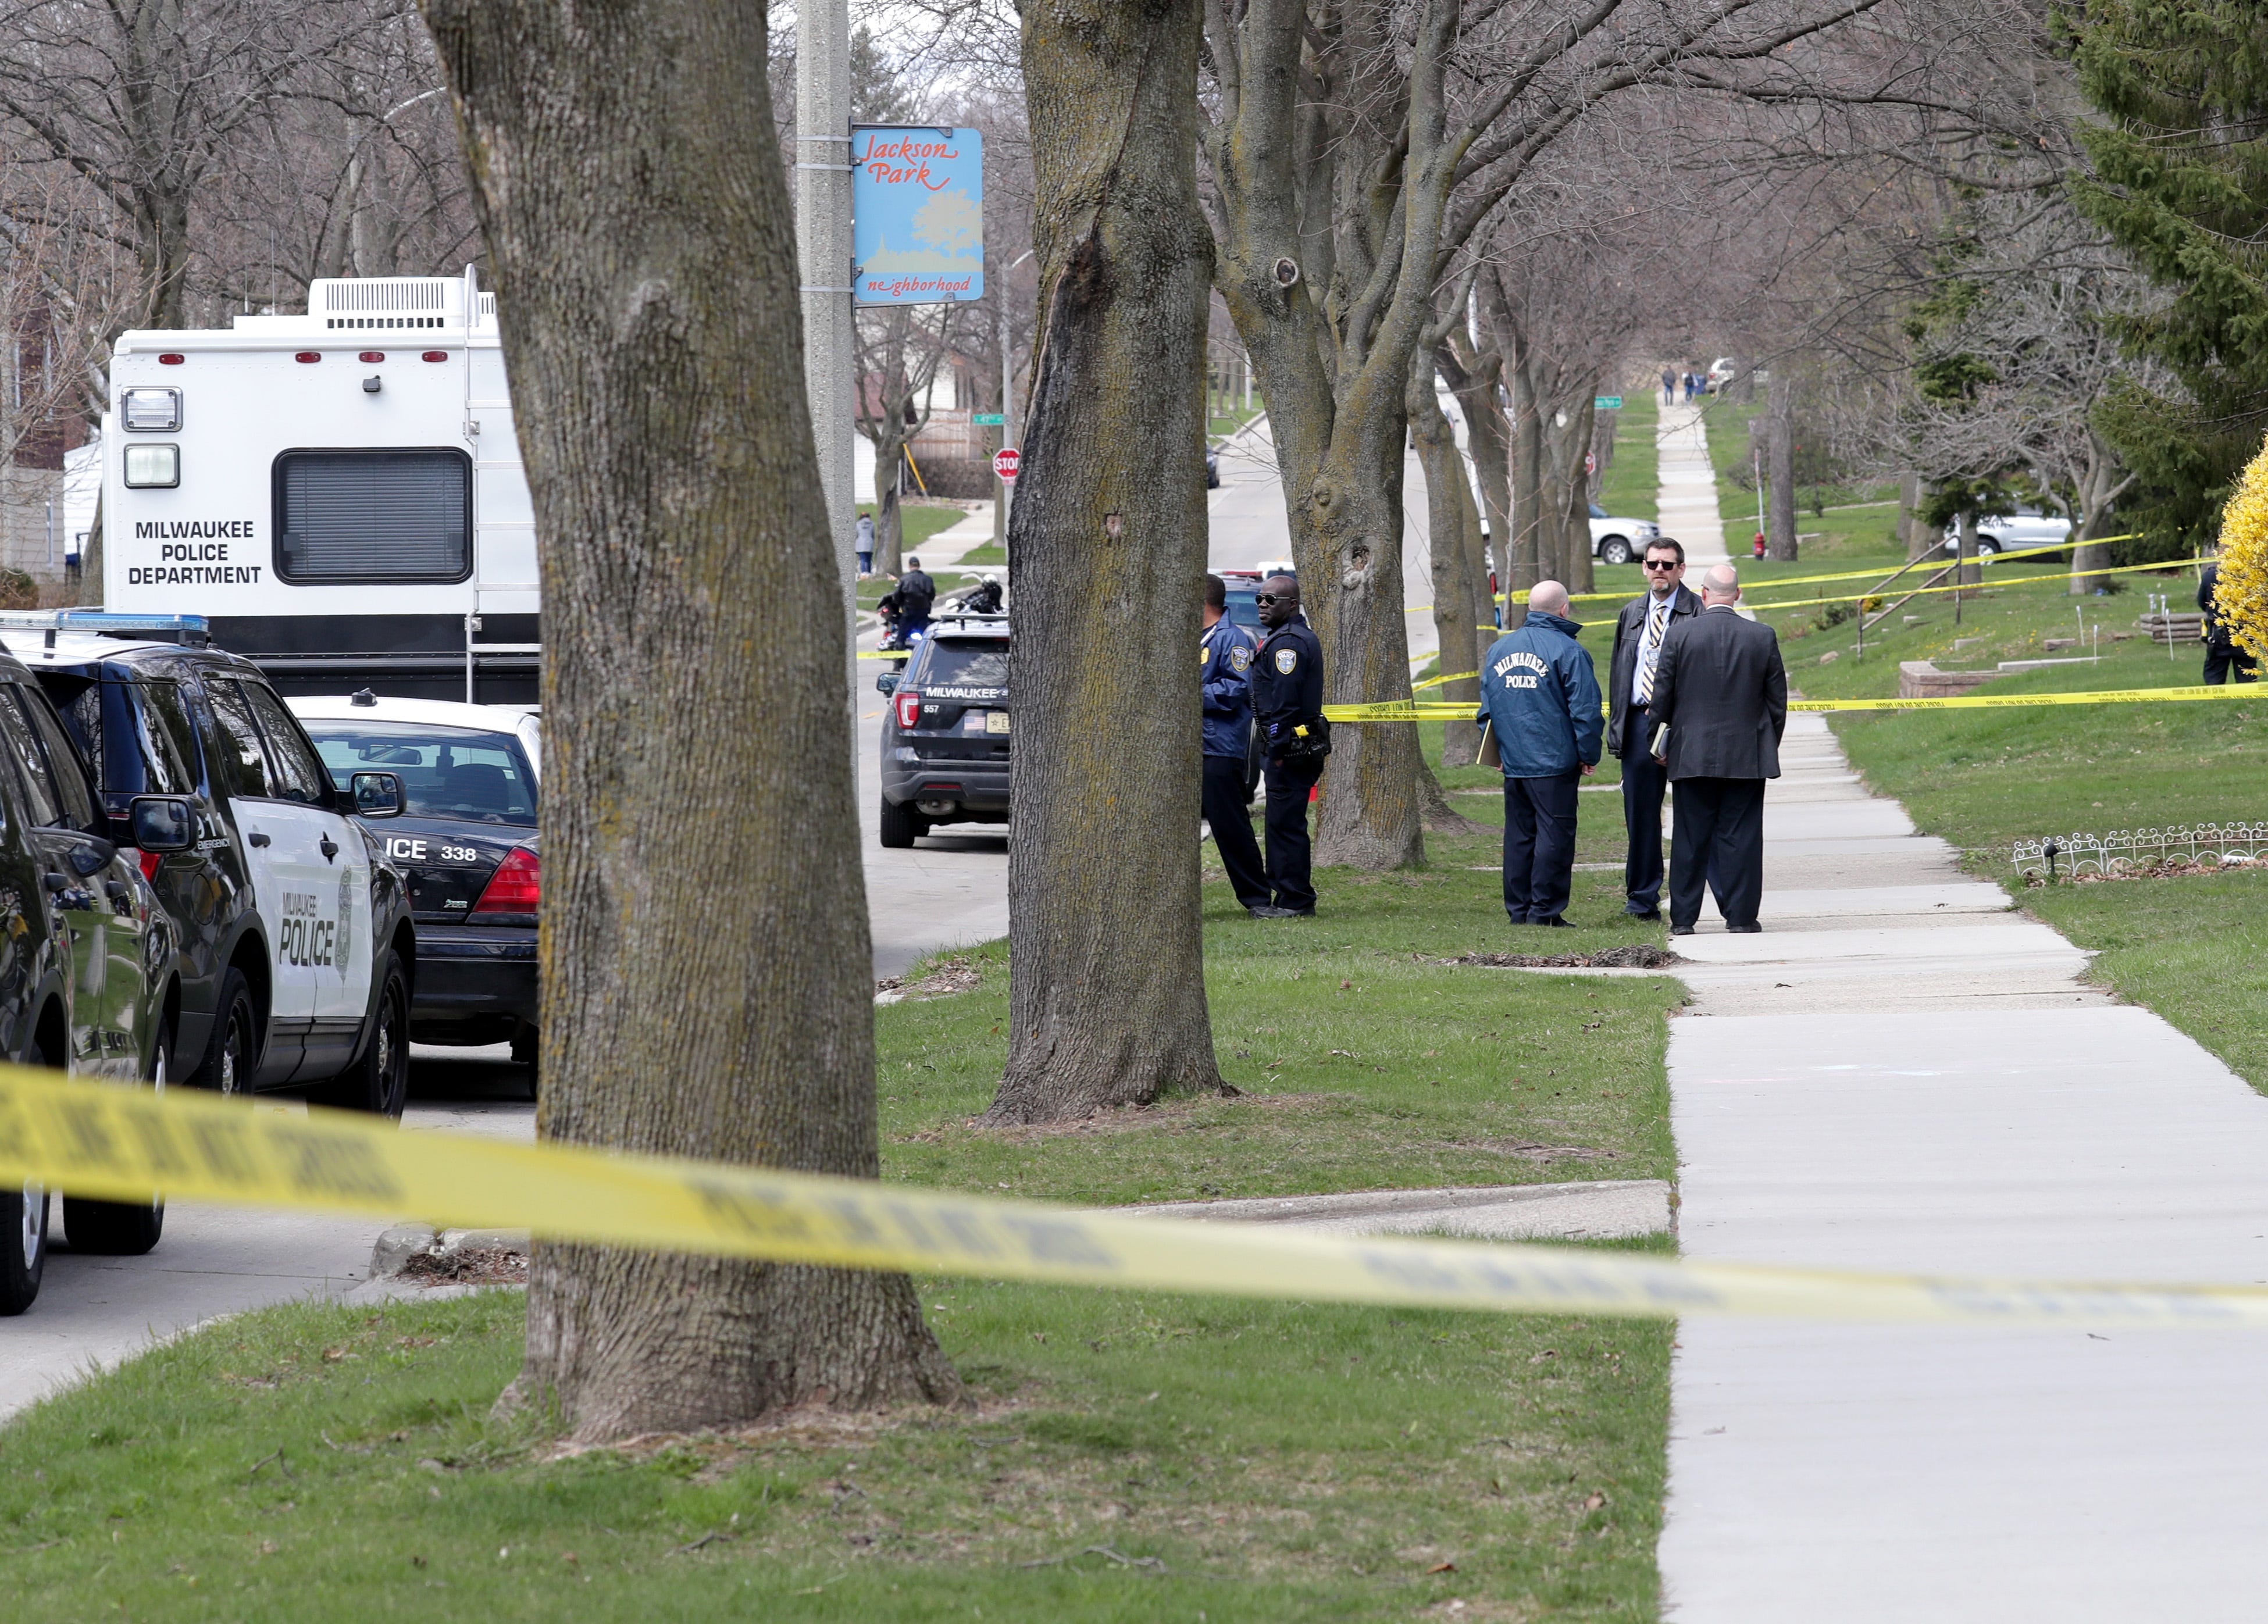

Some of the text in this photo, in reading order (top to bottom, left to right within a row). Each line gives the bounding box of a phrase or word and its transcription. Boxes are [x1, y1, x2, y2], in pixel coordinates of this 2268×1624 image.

[861, 134, 959, 166] Jackson
[868, 160, 951, 191] Park
[867, 276, 972, 297] neighborhood
[135, 521, 254, 538] MILWAUKEE
[162, 544, 229, 561] POLICE
[129, 566, 261, 584] DEPARTMENT
[1505, 675, 1538, 688] POLICE
[926, 686, 997, 698] MILWAUKEE
[923, 704, 940, 713] 557
[197, 838, 231, 850] EMERGENCY
[441, 845, 477, 862] 338
[283, 891, 316, 918] MILWAUKEE
[279, 918, 334, 968] POLICE
